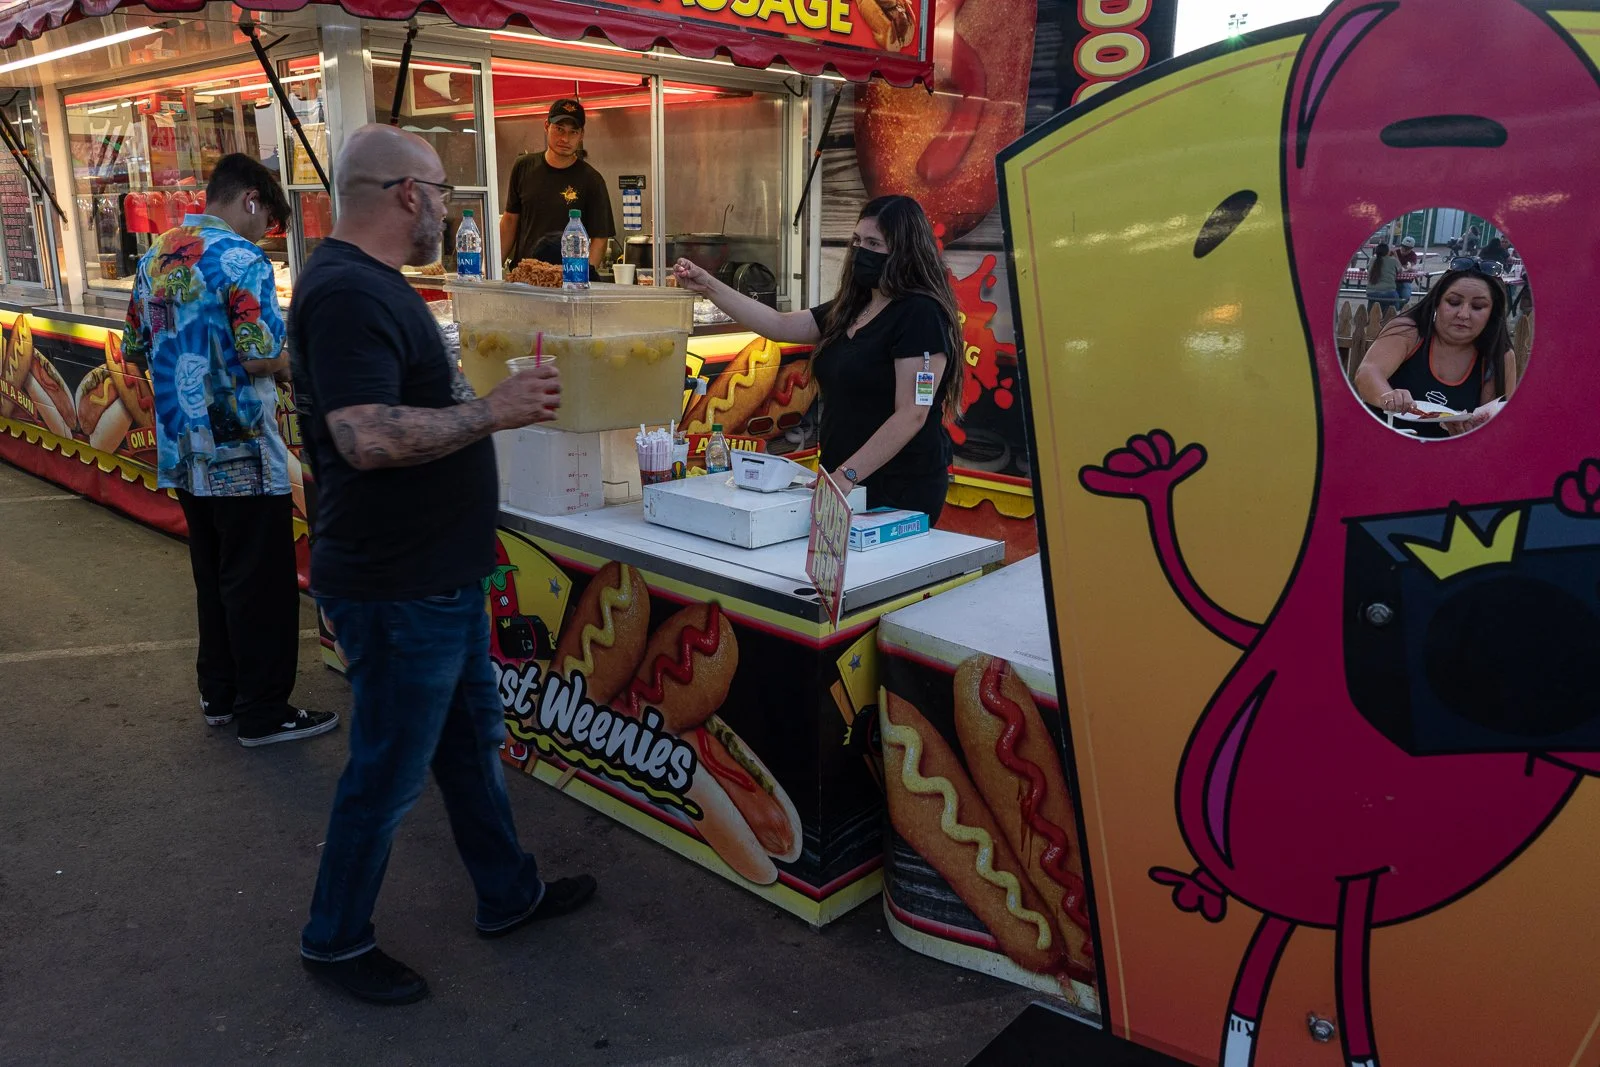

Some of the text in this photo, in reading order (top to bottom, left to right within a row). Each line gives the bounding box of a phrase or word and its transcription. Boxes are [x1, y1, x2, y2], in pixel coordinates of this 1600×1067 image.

[17, 391, 34, 414] BUN
[130, 430, 156, 449] ON A
[539, 674, 693, 789] Weenies
